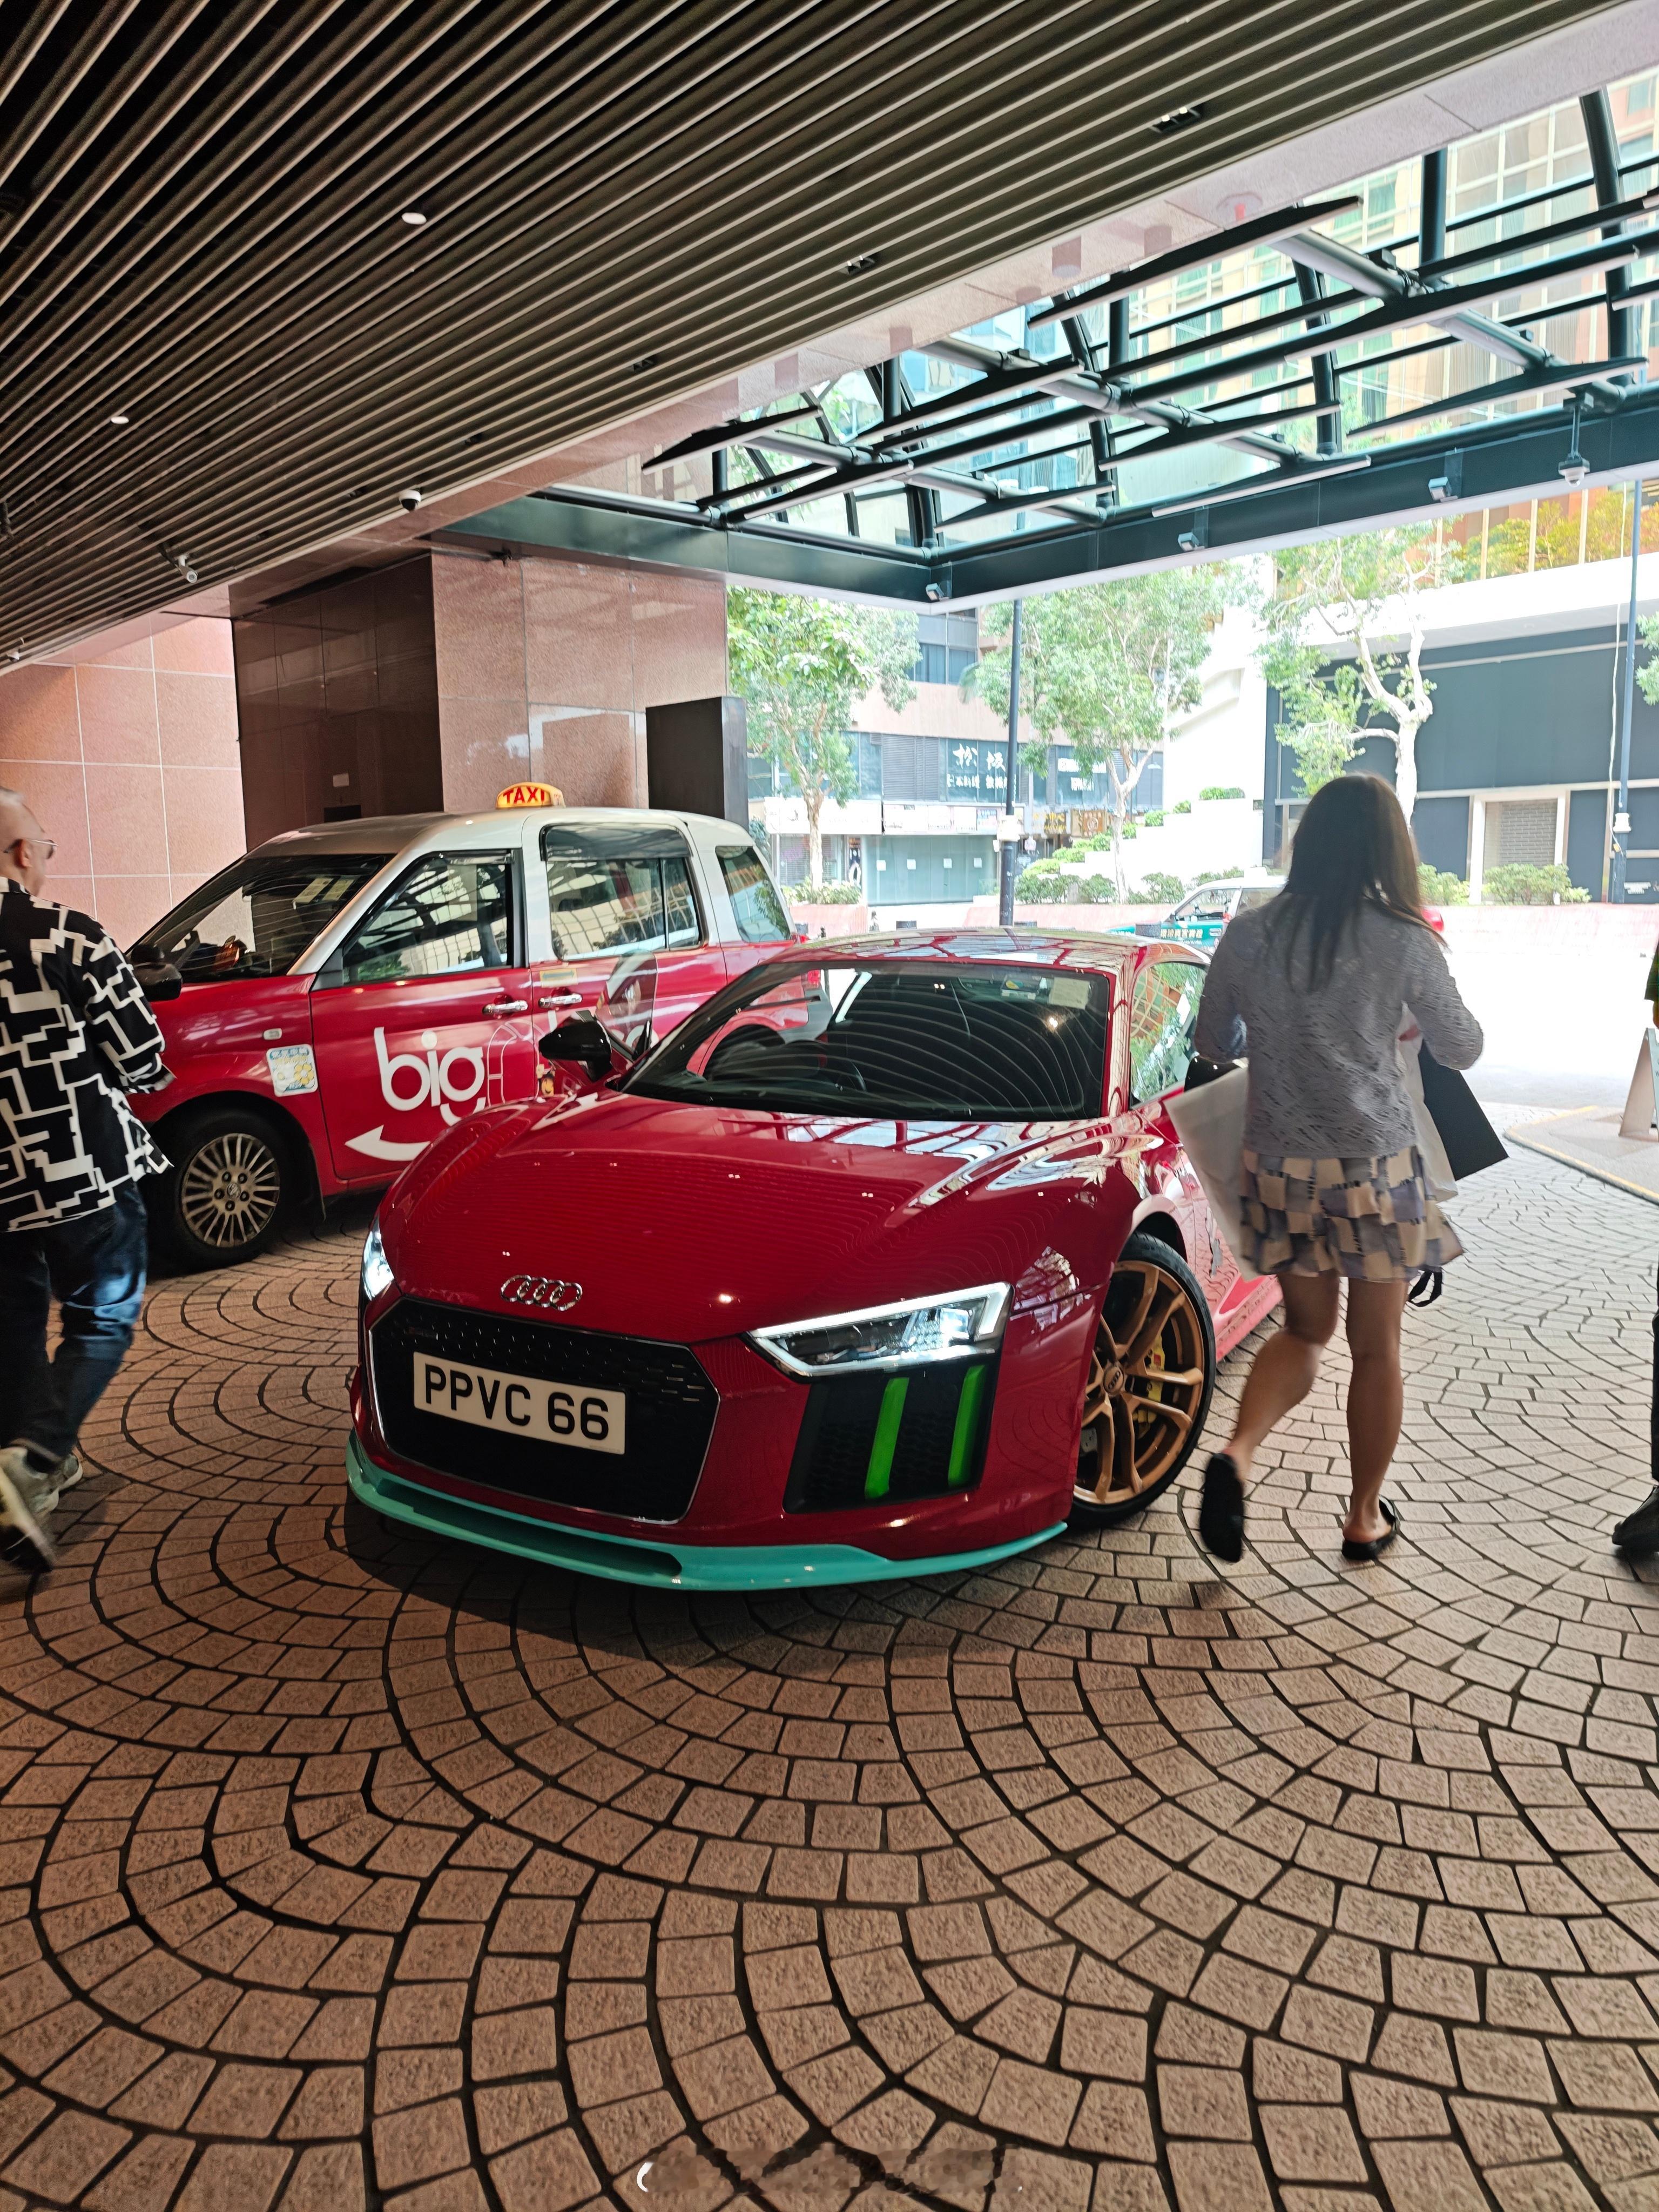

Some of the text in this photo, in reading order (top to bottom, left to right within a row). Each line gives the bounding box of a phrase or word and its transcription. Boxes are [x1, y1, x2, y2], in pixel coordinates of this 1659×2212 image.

[503, 786, 545, 804] TAXI
[374, 1026, 485, 1127] big
[425, 1364, 609, 1440] PPVC 66
